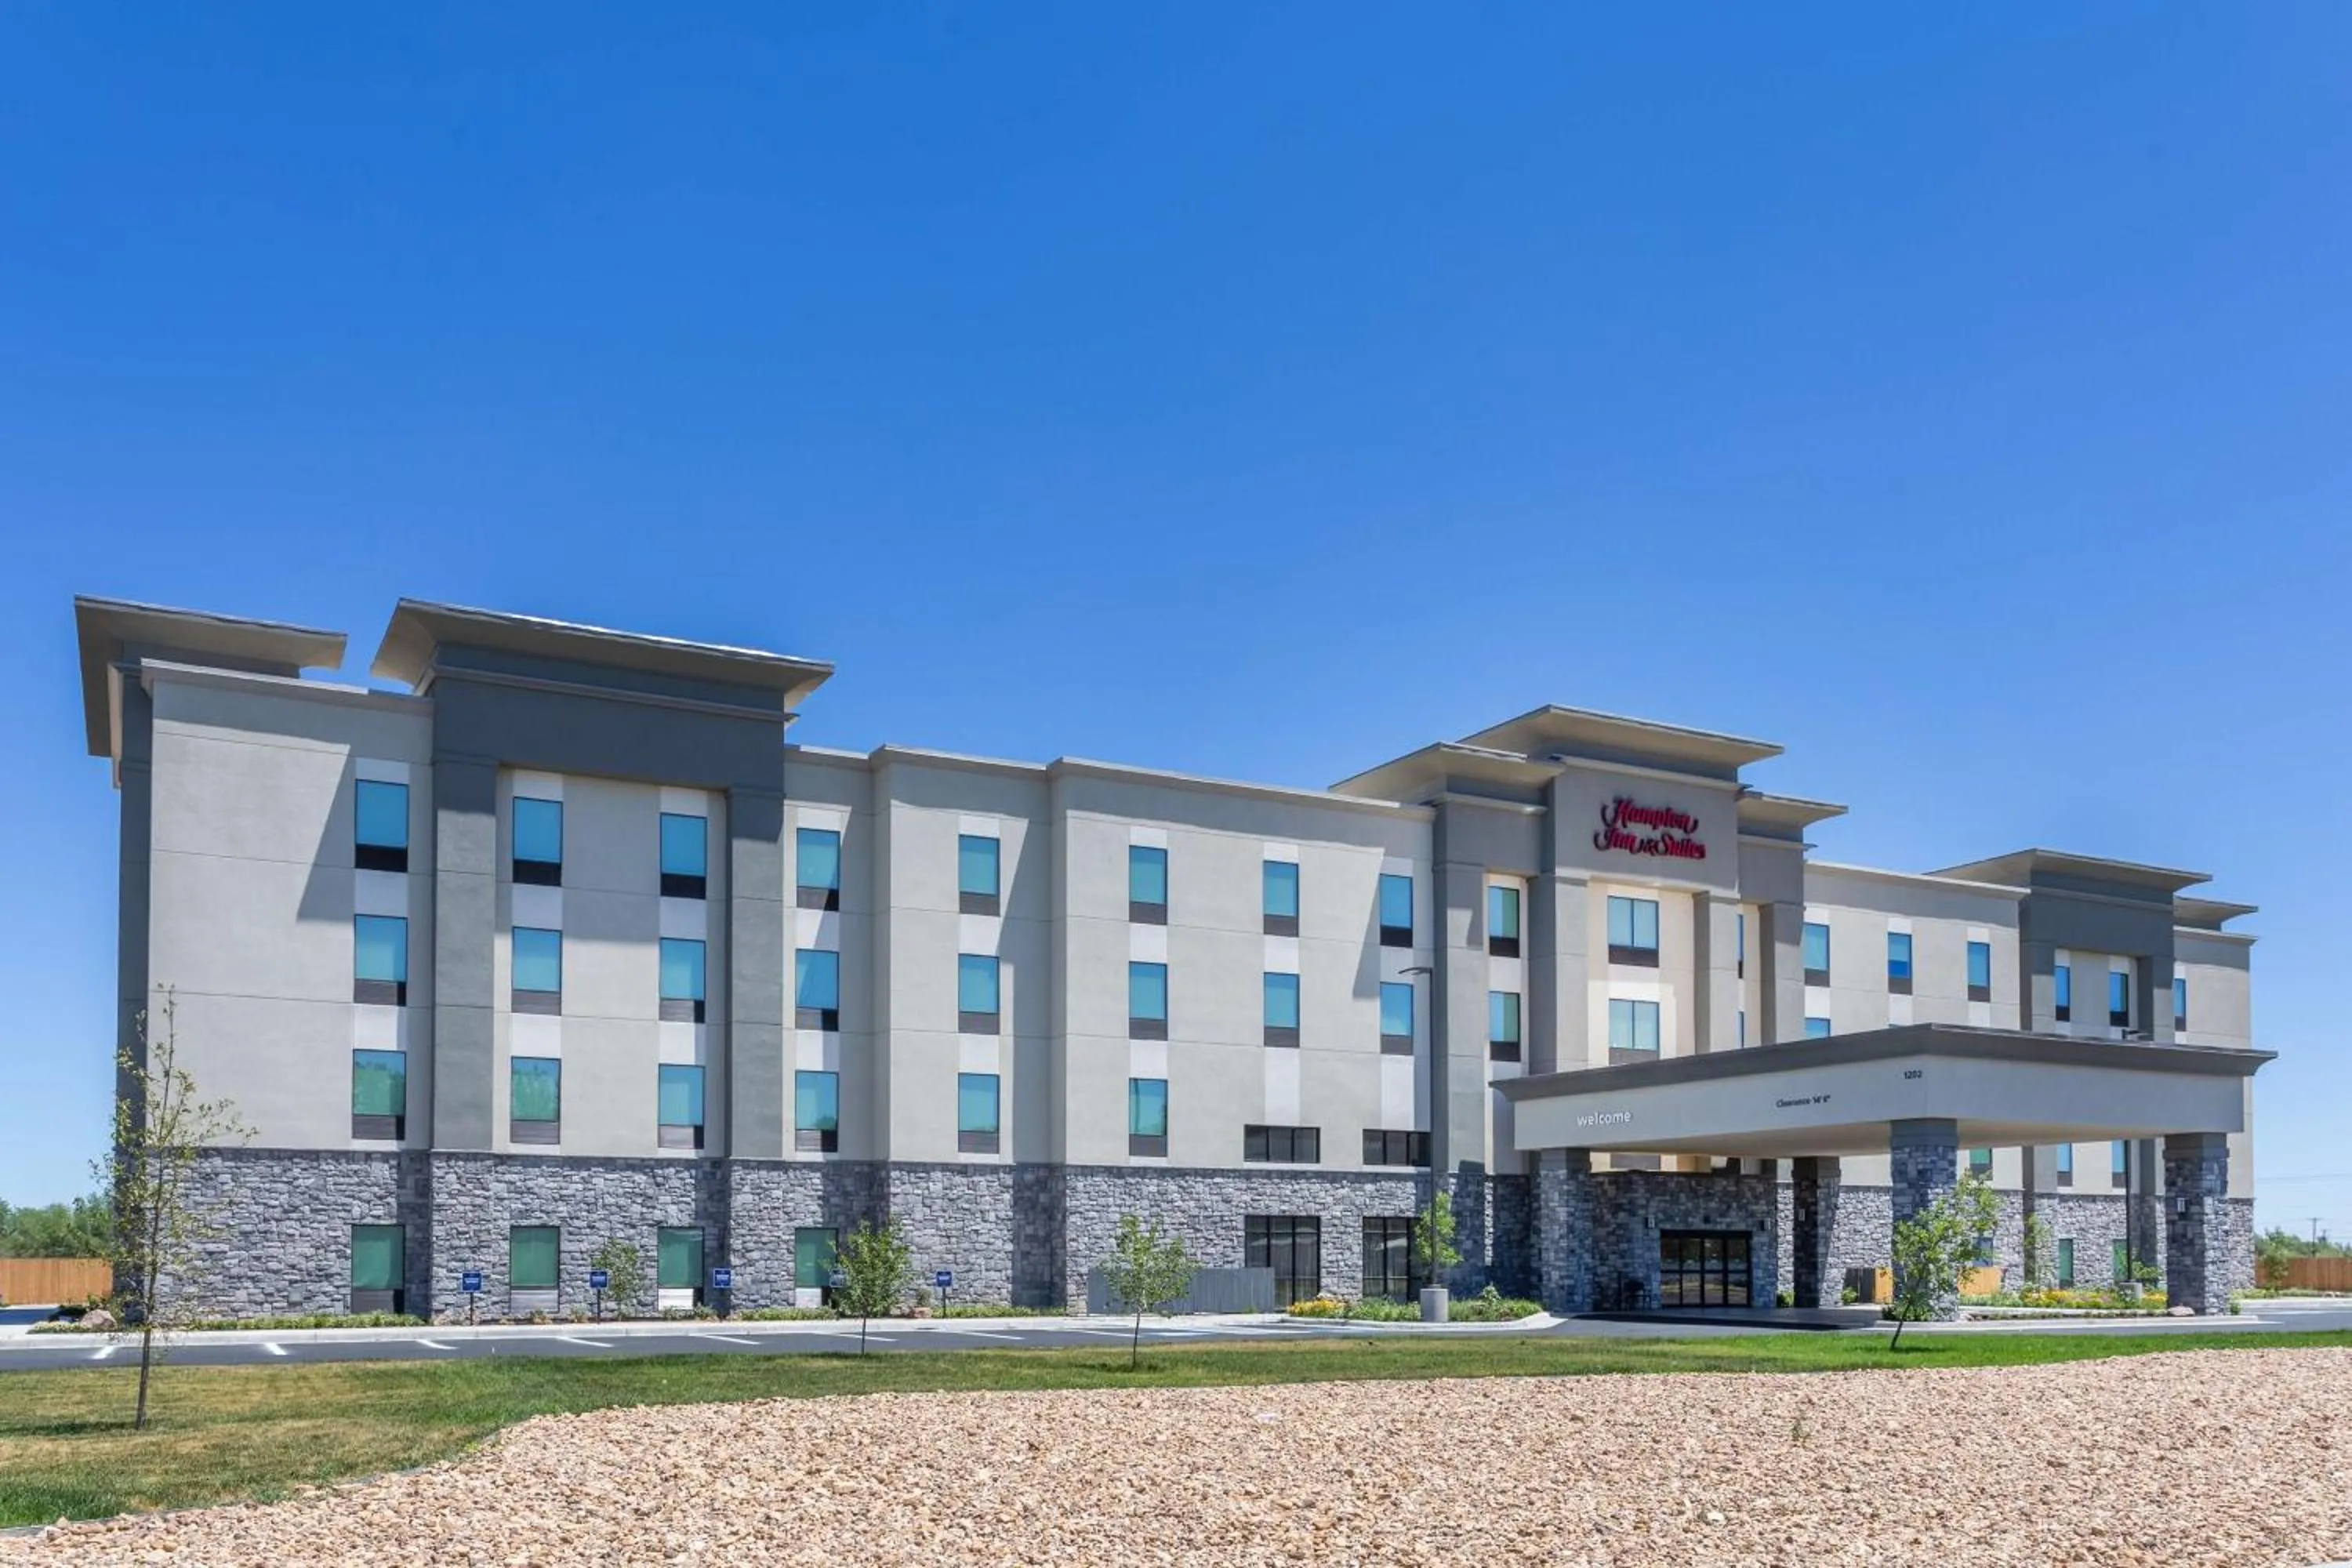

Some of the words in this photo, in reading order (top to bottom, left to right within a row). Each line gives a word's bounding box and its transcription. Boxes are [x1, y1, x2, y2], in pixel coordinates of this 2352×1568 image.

[1601, 797, 1699, 833] Hampton
[1593, 827, 1643, 855] Inn
[1655, 833, 1706, 859] Suites
[1577, 1110, 1632, 1127] welcome
